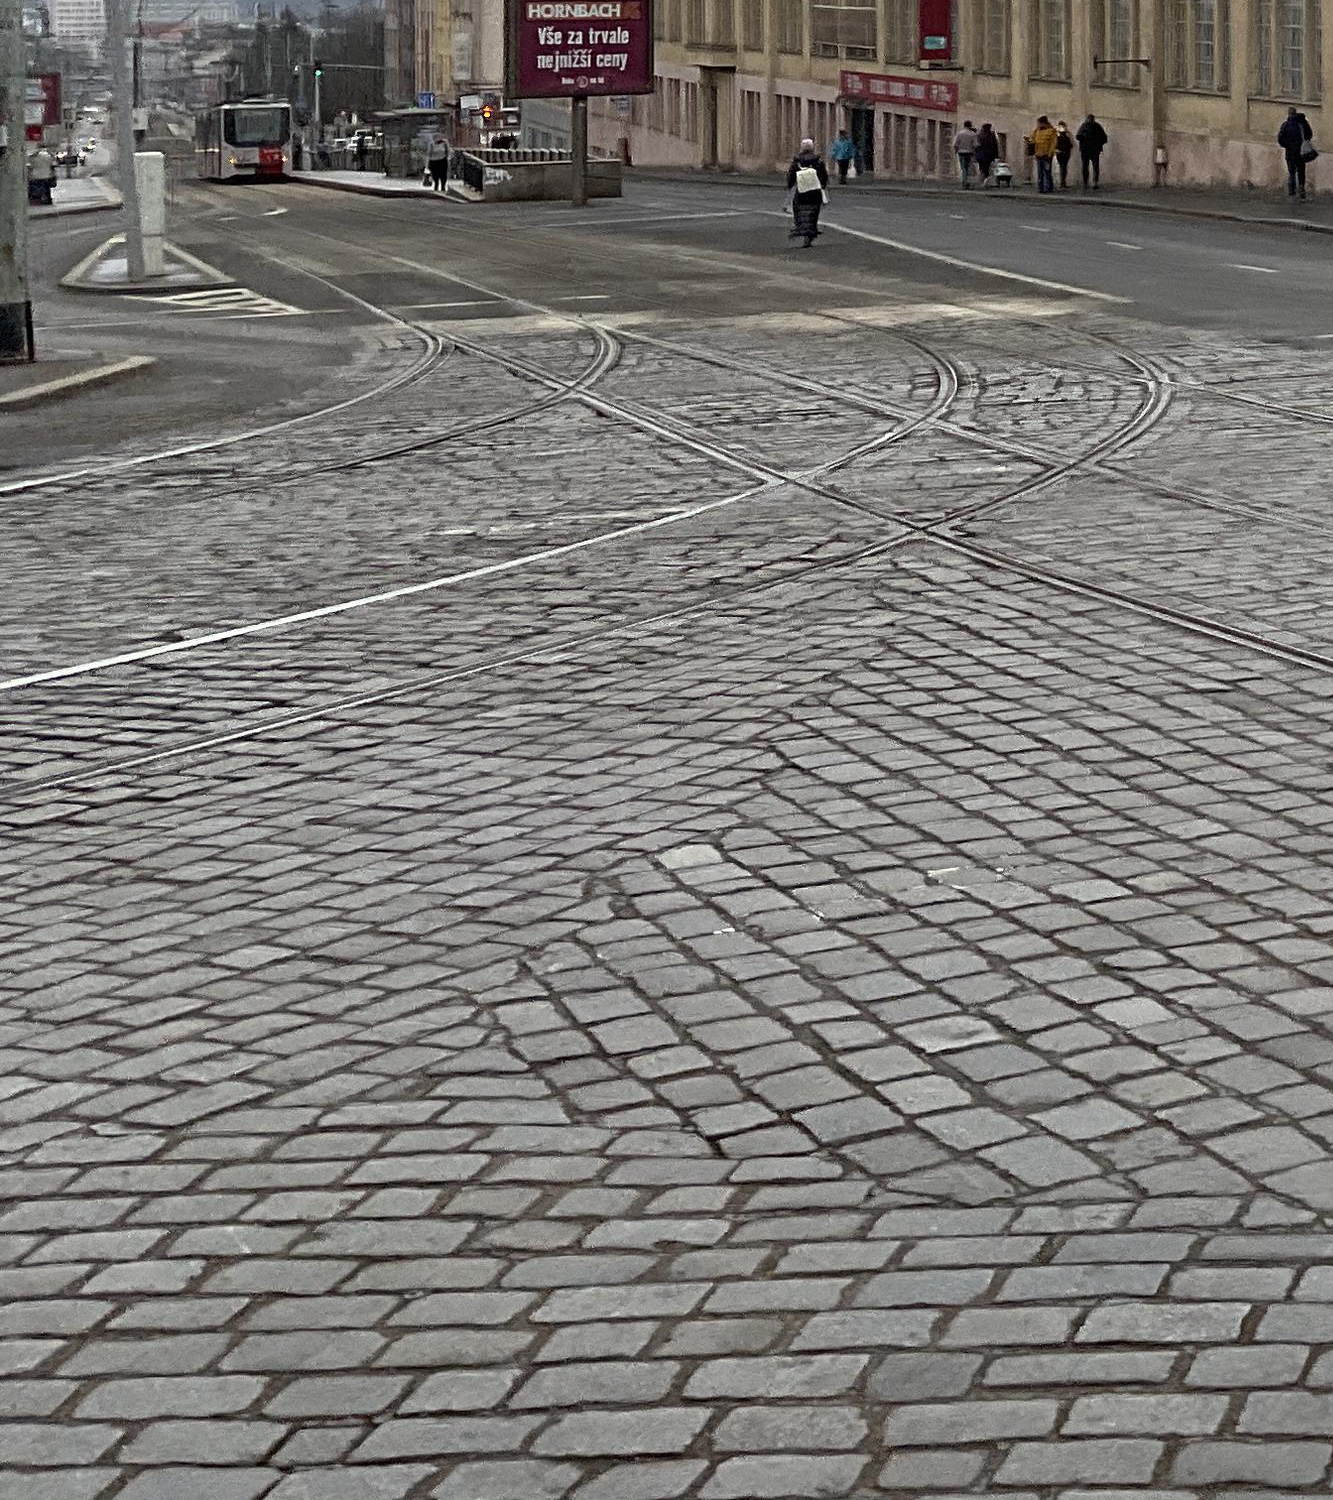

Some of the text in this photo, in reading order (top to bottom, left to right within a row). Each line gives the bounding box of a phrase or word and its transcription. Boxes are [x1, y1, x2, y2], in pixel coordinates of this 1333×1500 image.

[528, 3, 621, 19] HORNBACH
[538, 26, 630, 45] Vše za trvale
[537, 49, 628, 73] nejnižší ceny
